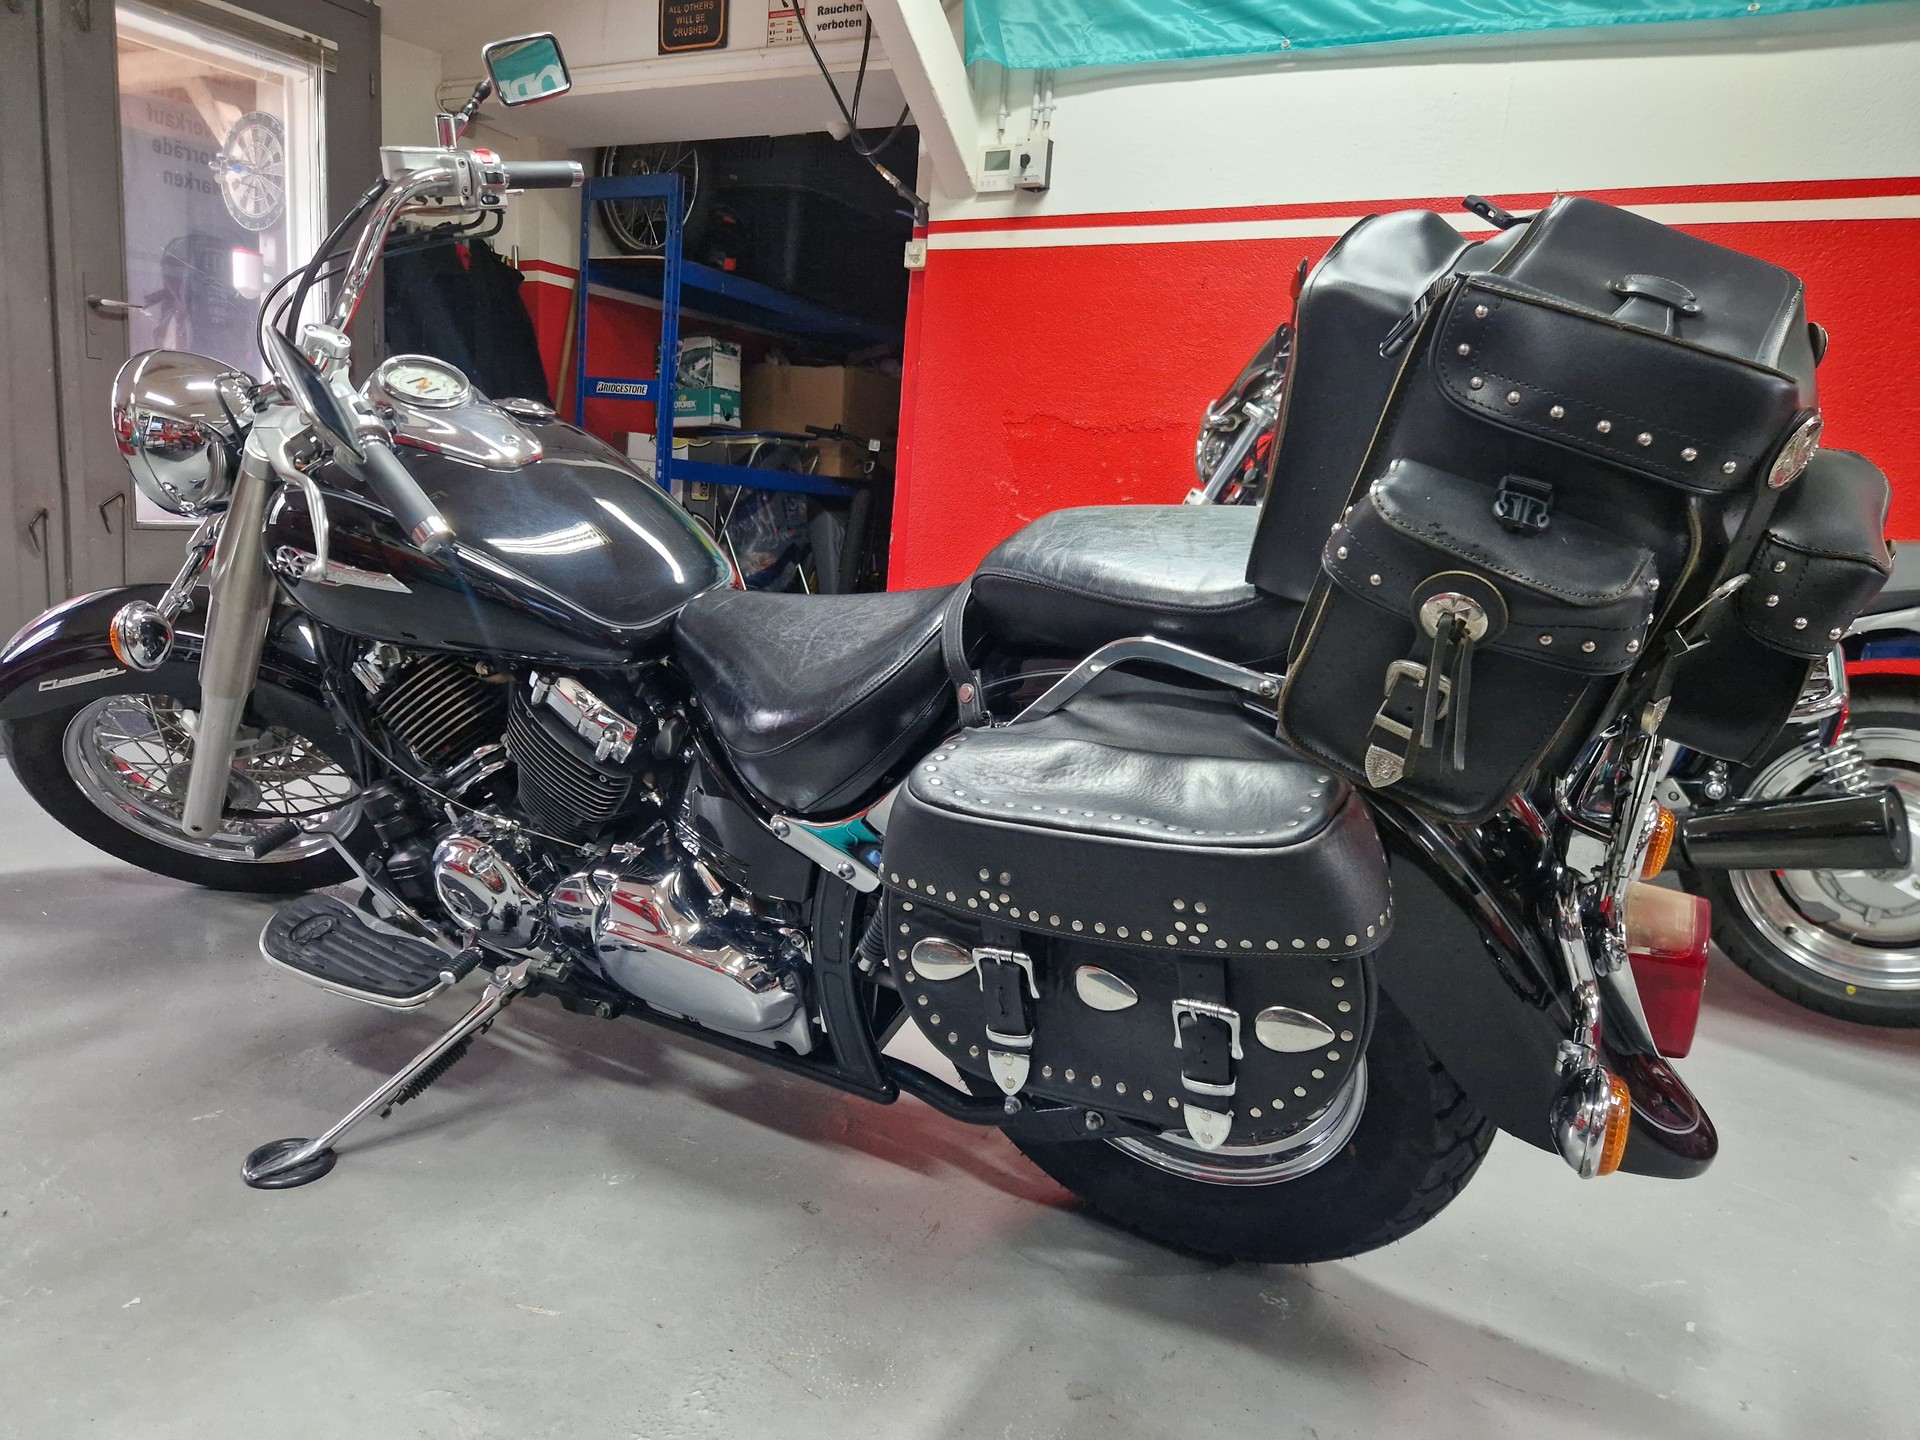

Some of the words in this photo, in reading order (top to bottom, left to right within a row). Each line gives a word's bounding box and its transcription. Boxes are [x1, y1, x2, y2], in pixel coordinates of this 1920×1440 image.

[669, 6, 681, 14] ALL
[684, 1, 714, 13] OTHERS
[817, 3, 863, 16] Rauchen
[676, 15, 693, 24] WILL
[695, 13, 705, 23] BE
[816, 18, 862, 31] verboten
[672, 25, 709, 37] CRUSHED
[597, 382, 647, 395] BRIDGESTONE
[673, 400, 696, 409] OTOREX
[38, 667, 127, 692] Claic
